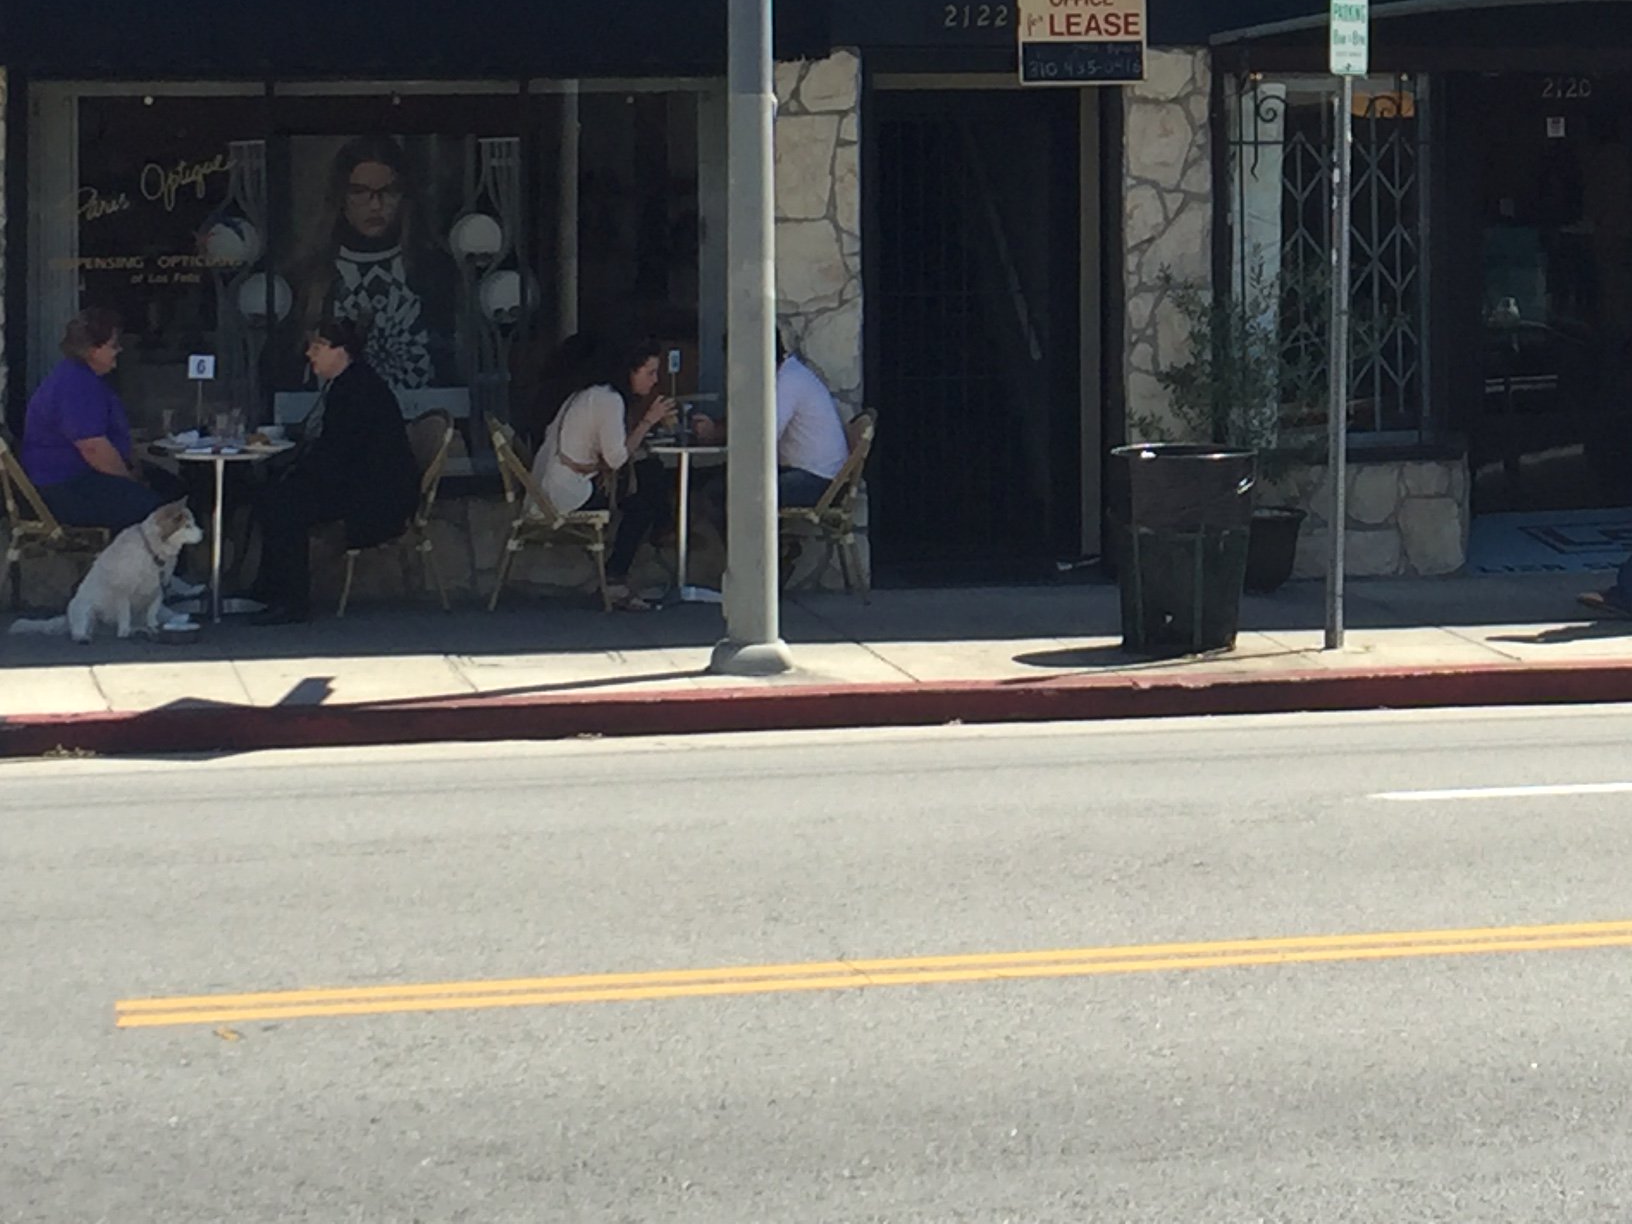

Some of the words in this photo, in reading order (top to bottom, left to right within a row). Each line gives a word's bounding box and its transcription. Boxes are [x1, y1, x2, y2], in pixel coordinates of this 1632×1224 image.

[944, 4, 1008, 28] 2122
[1049, 13, 1140, 36] LEASE
[1541, 77, 1592, 98] 2120
[48, 255, 145, 269] PENSING
